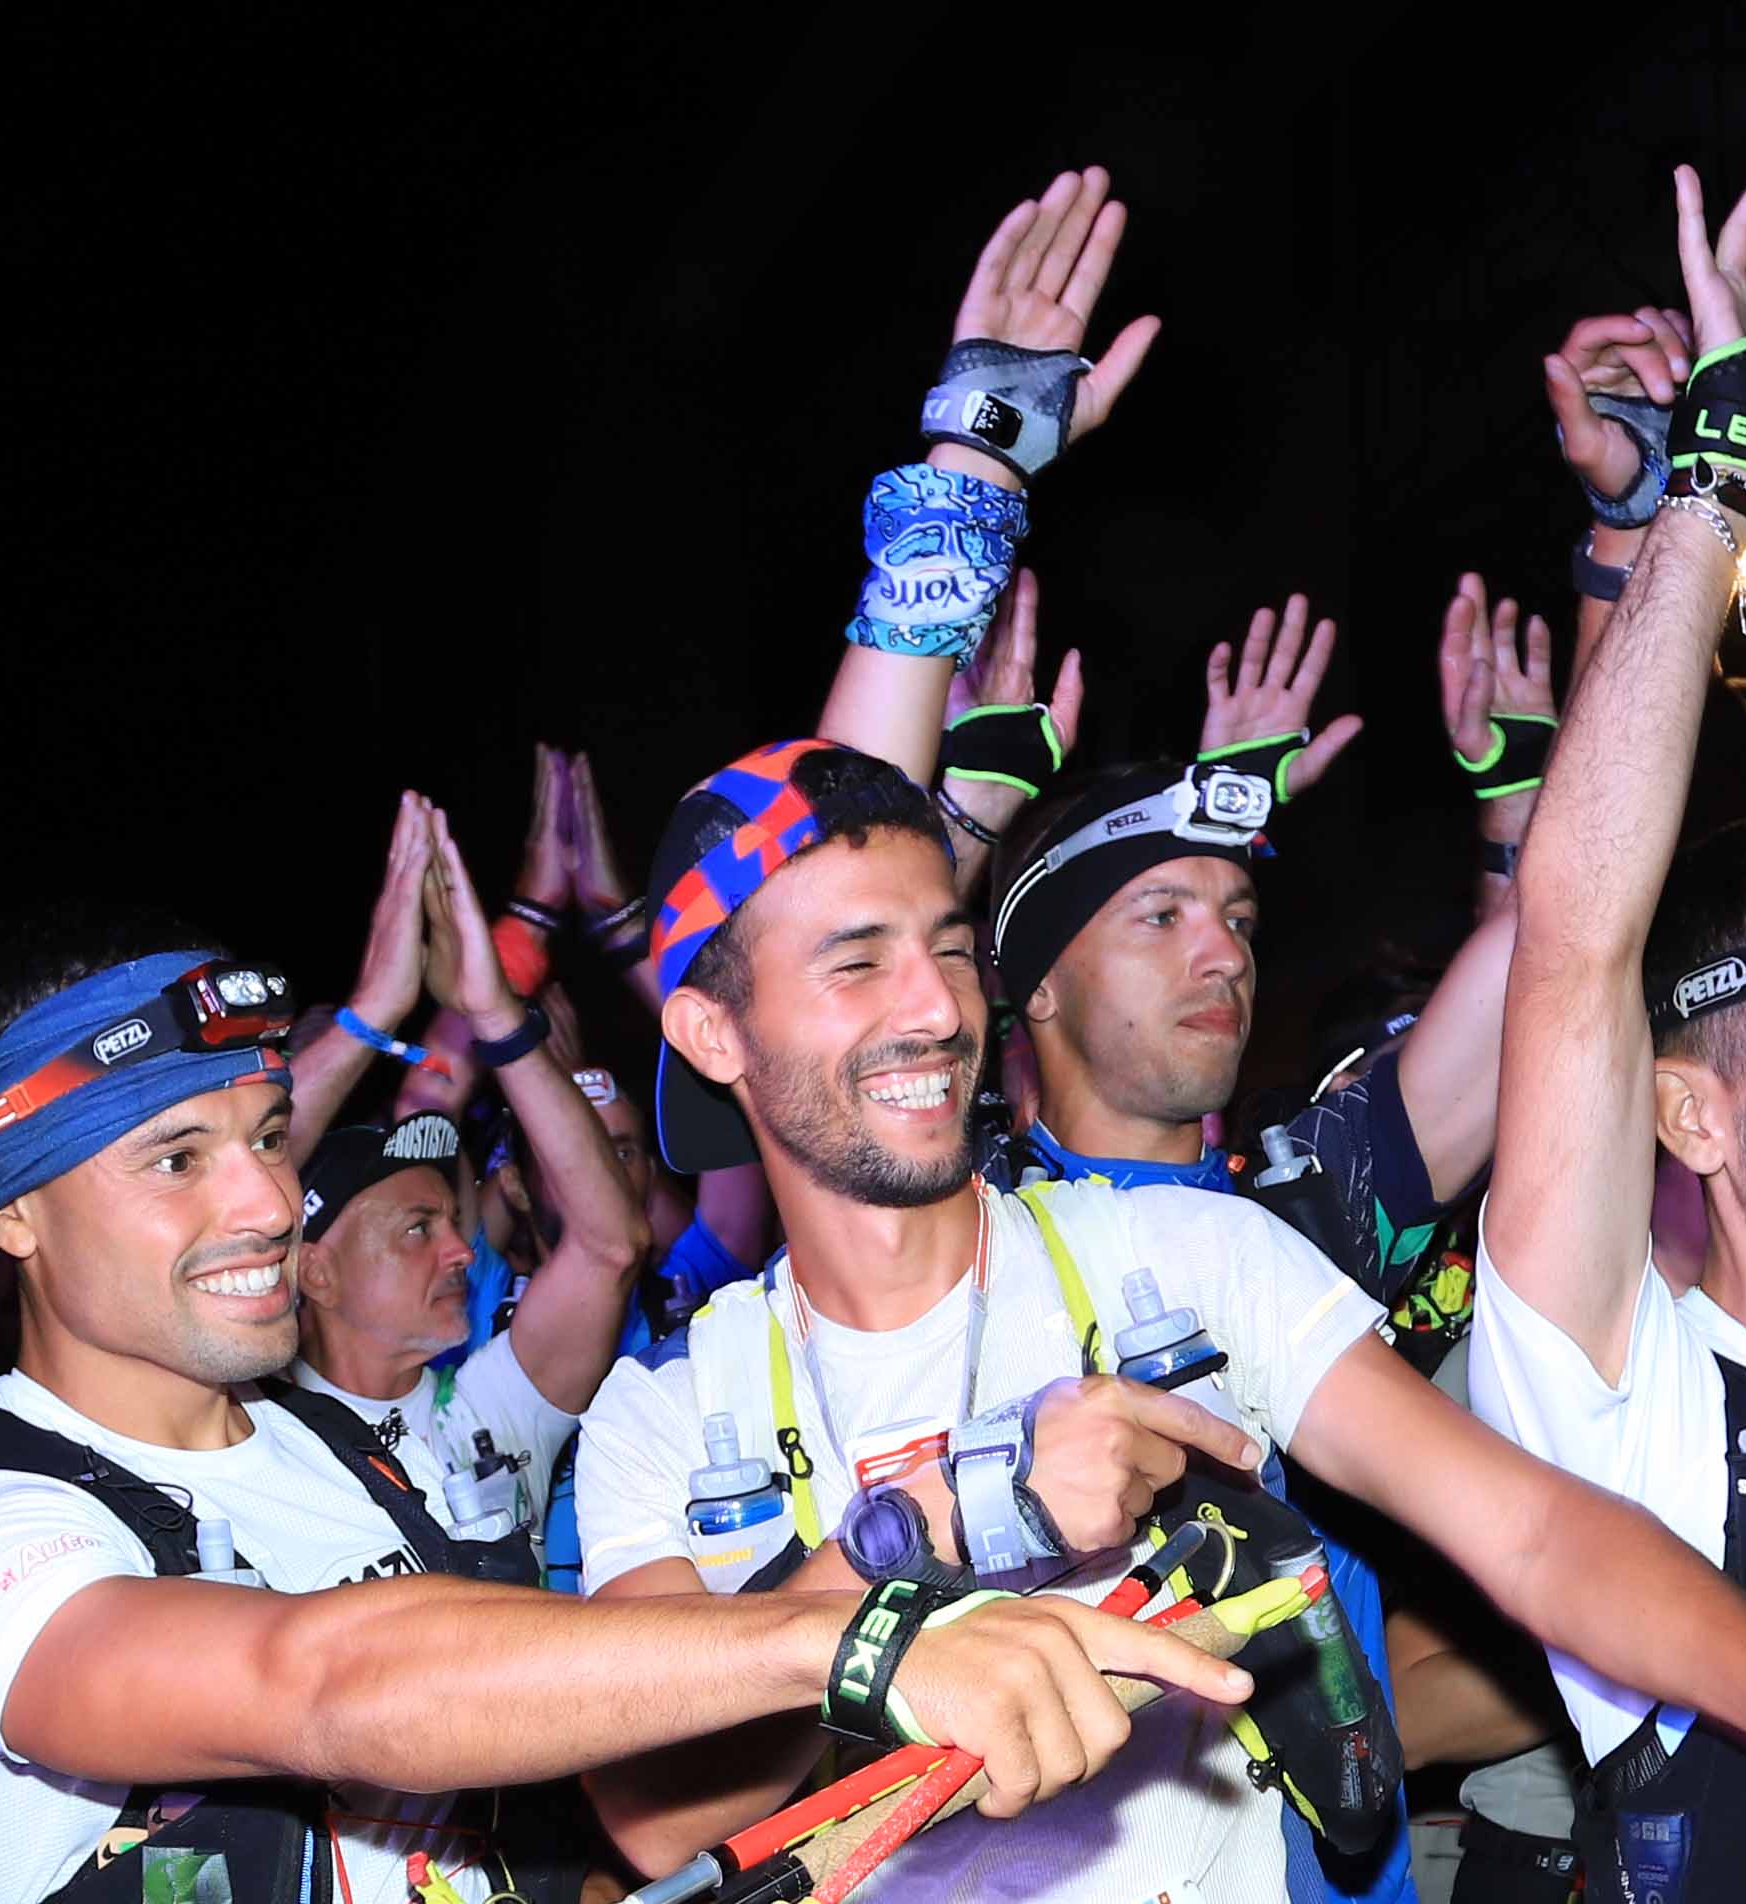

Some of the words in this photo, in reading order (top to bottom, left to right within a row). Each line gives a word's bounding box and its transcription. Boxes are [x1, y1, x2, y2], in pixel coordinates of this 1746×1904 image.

[1106, 810, 1151, 836] PETZL
[96, 1023, 152, 1065] PETZL
[838, 1580, 919, 1699] LEKI
